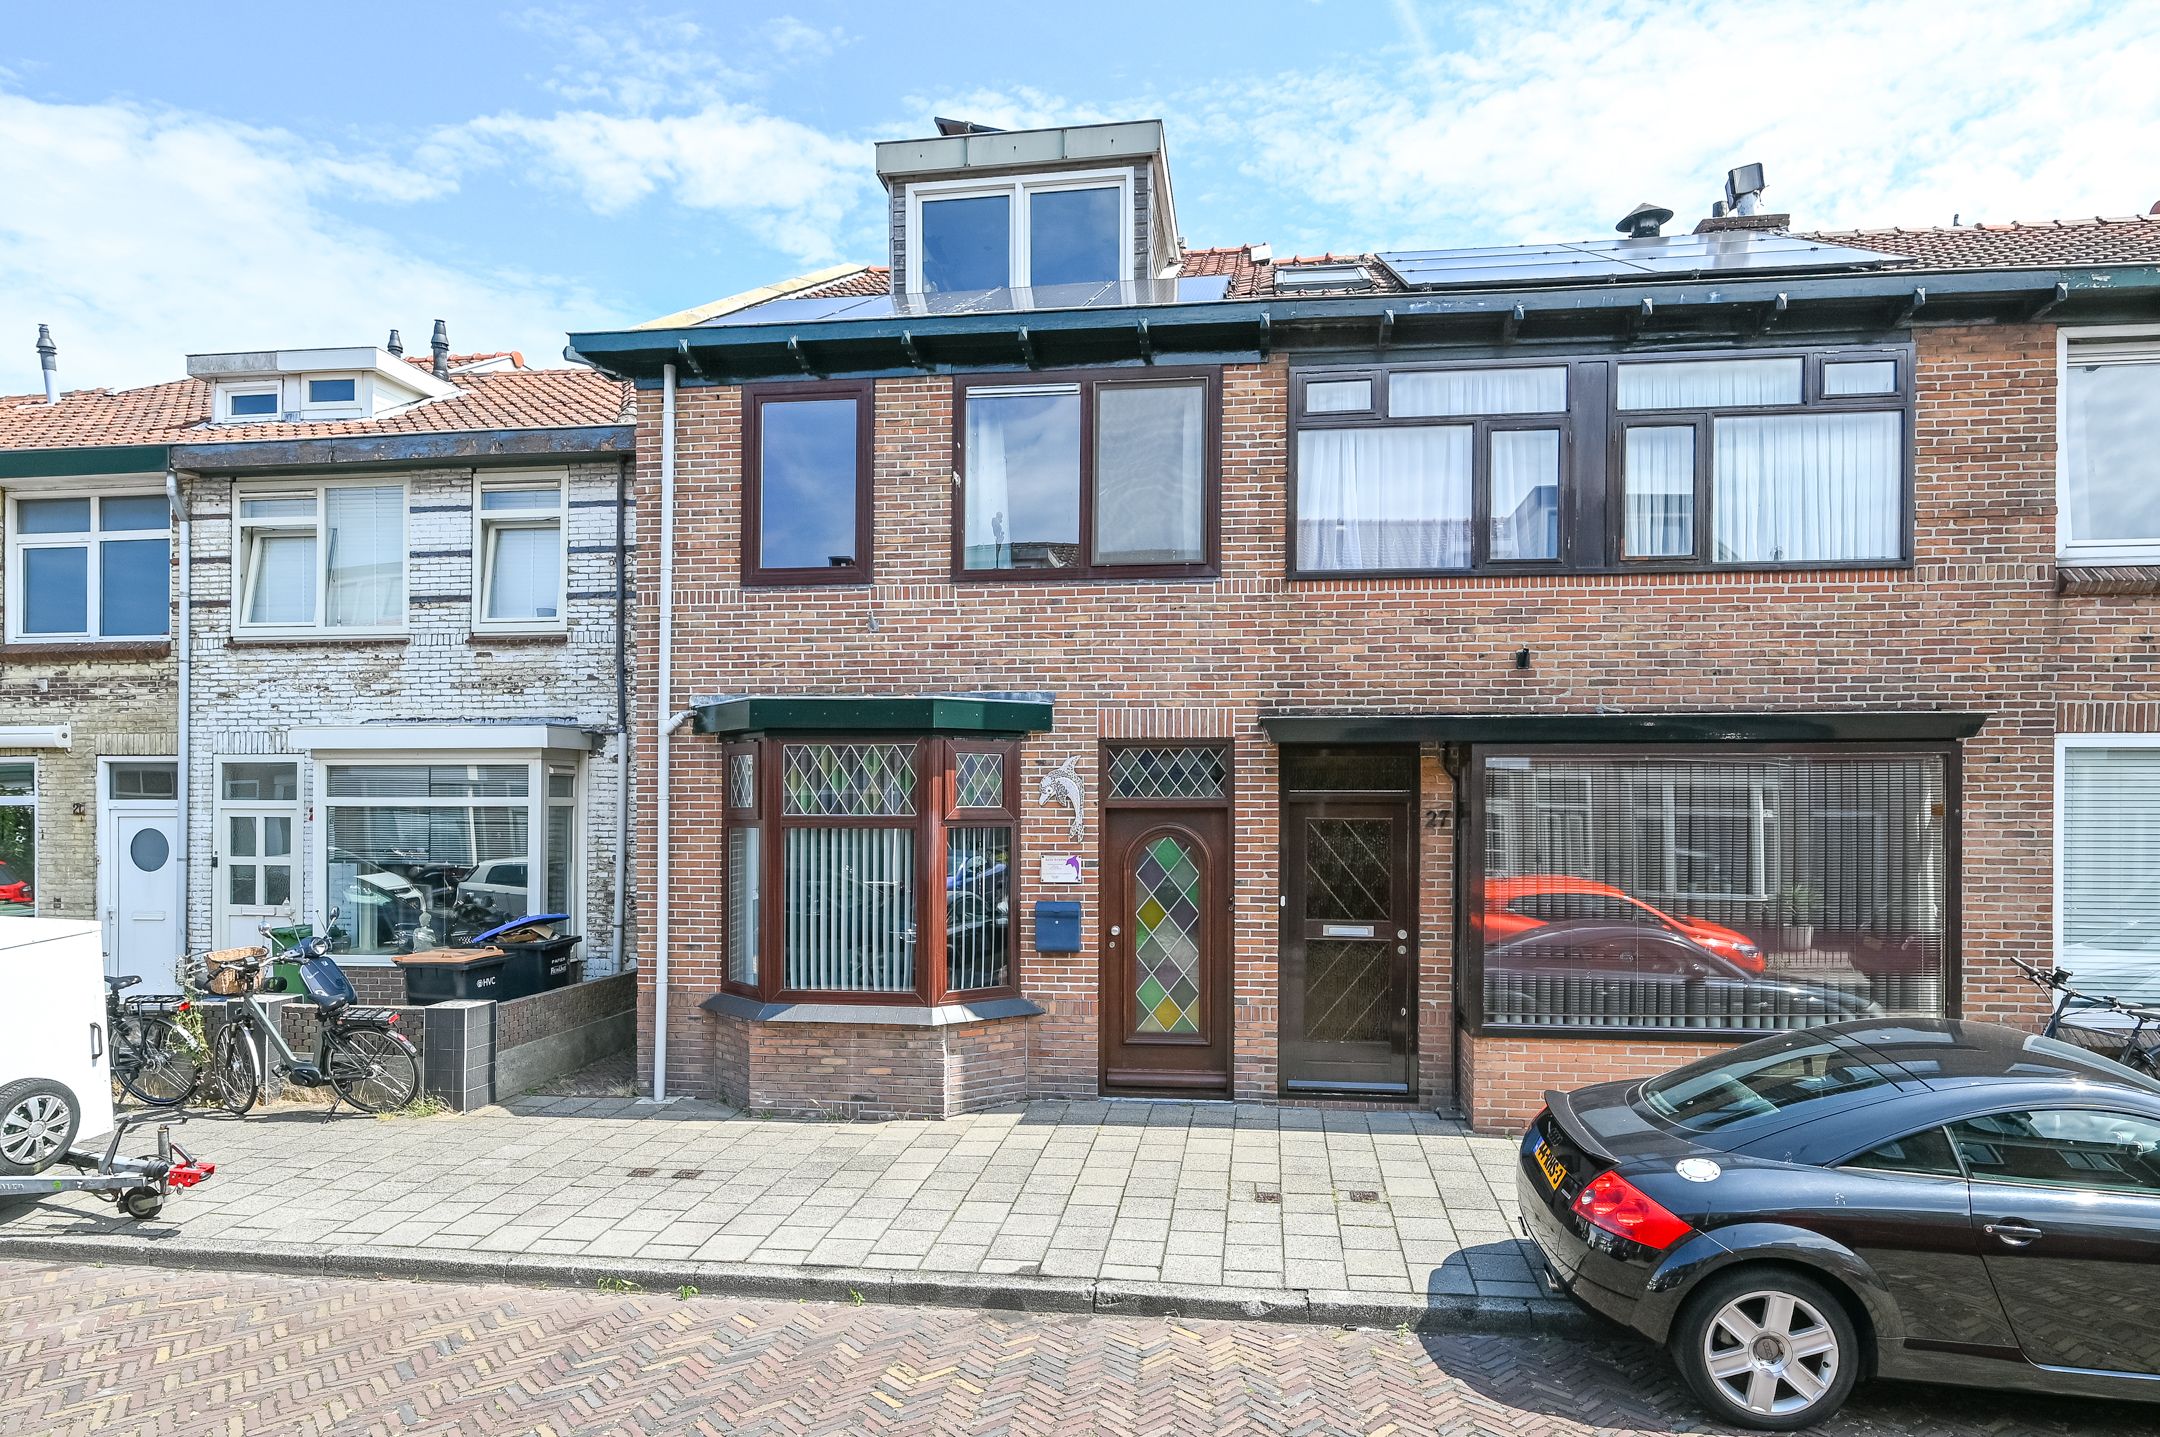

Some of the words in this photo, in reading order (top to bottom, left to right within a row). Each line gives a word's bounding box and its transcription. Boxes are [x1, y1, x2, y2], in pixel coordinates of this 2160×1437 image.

[1425, 810, 1451, 827] 27
[483, 976, 496, 987] HVC
[1538, 1142, 1563, 1184] 44-RHS-3
